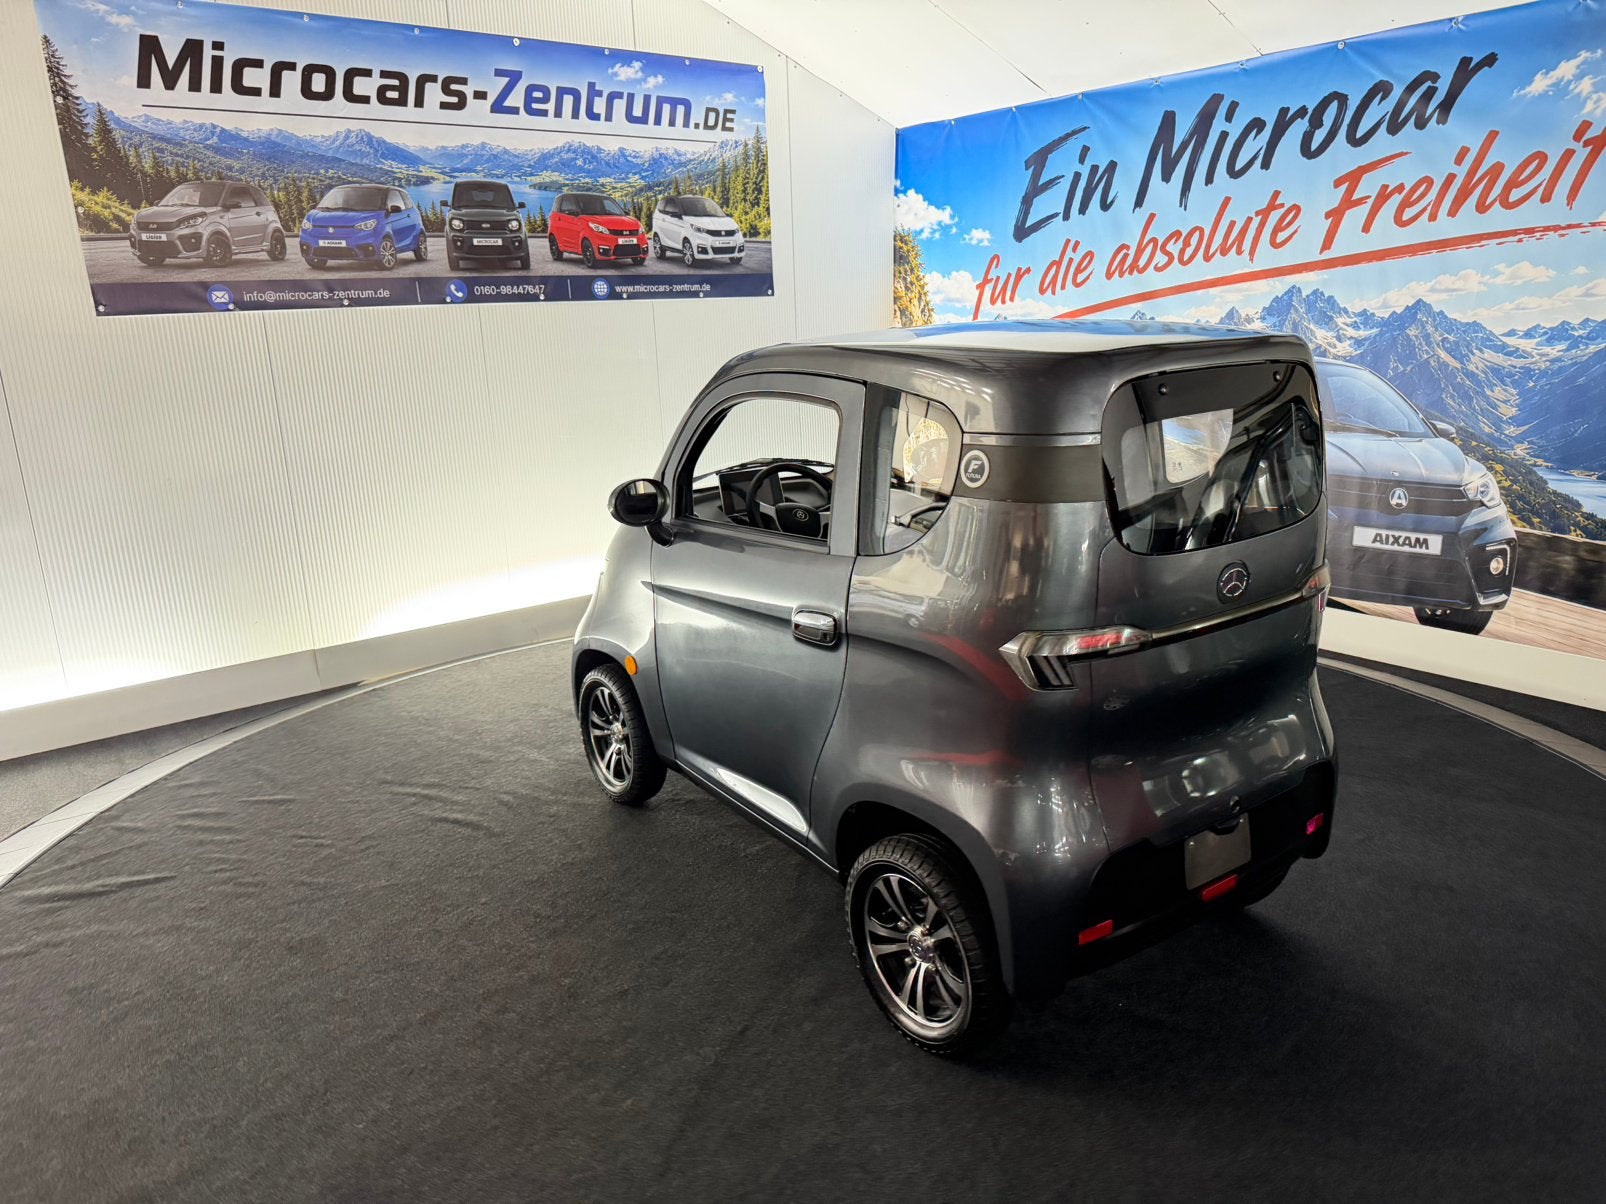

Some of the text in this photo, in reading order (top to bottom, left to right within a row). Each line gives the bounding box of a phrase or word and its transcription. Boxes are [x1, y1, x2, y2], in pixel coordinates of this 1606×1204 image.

[136, 34, 737, 133] Microcars-Zentrum.DE
[1013, 52, 1498, 243] Ein Microcar
[972, 119, 1606, 321] fur die absolute Freiheit
[243, 288, 390, 302] info@microcars-zentrum.de
[474, 284, 545, 295] 0160-98447647
[615, 283, 711, 293] www.microcars-zentrum.de
[1371, 532, 1429, 550] AIXAM
